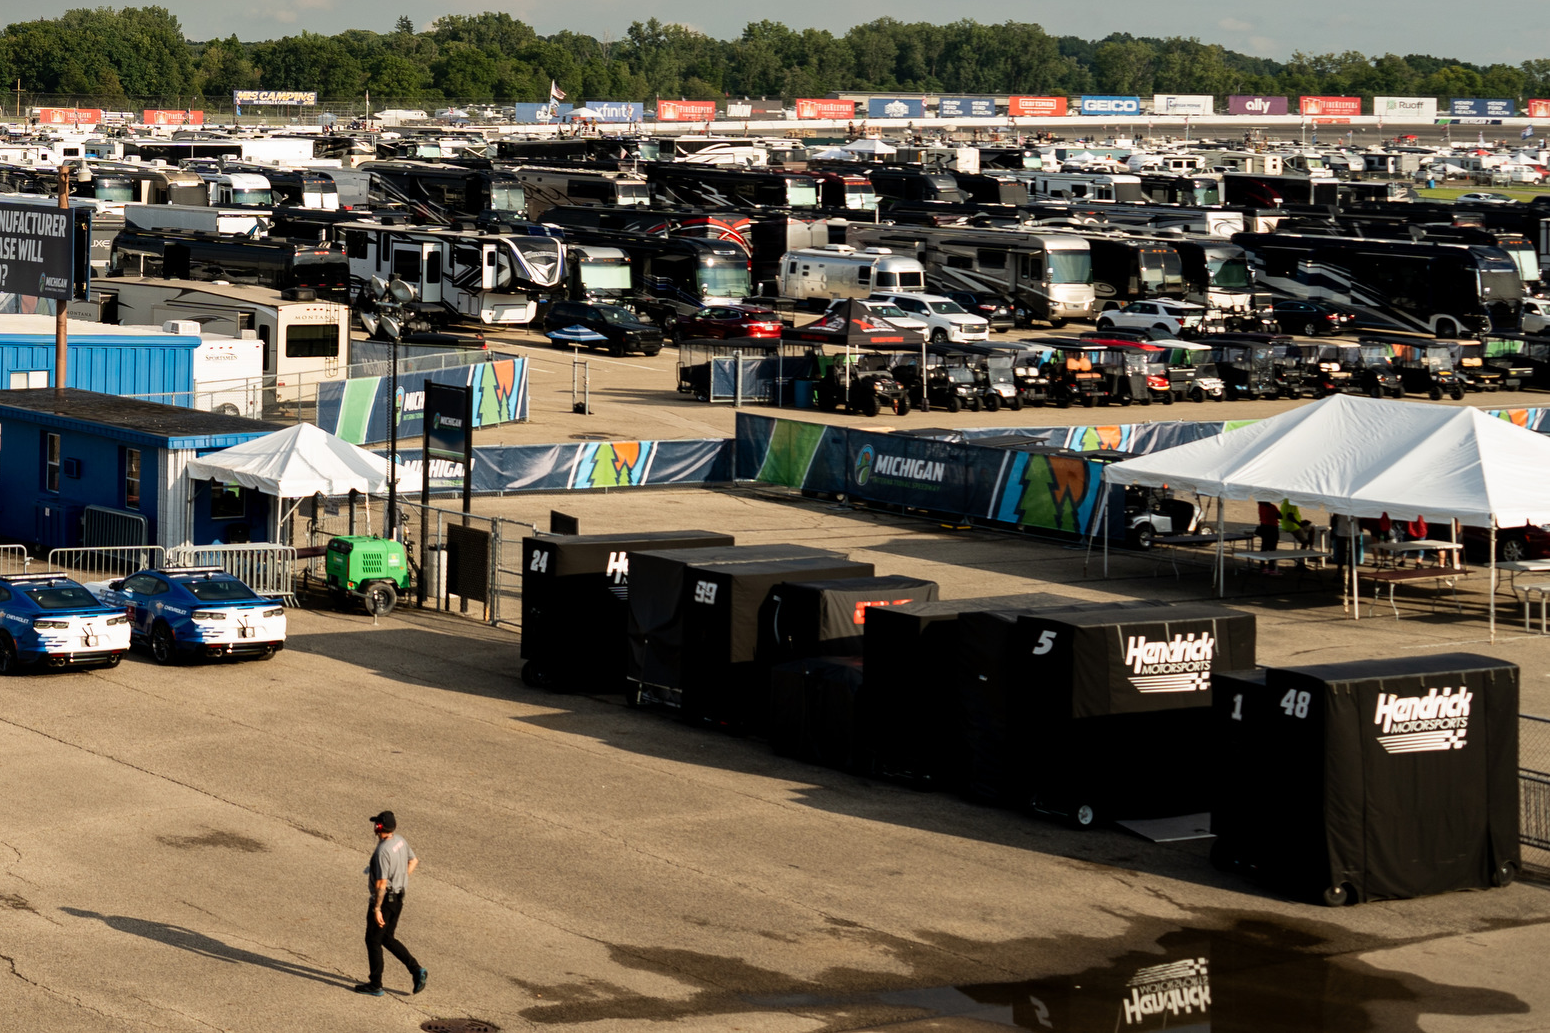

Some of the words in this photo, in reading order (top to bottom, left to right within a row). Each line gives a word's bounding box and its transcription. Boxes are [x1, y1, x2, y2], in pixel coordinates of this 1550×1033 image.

[259, 92, 315, 101] CAMPING
[1399, 101, 1424, 109] Ruoff
[595, 103, 635, 121] xfinity
[1084, 100, 1137, 112] GEICO
[1245, 98, 1270, 114] ally
[18, 239, 43, 263] WILL
[45, 276, 68, 288] MICHIGAN
[404, 391, 425, 411] MICH
[440, 416, 462, 427] MICHIGAN
[874, 454, 945, 482] MICHIGAN
[530, 549, 549, 573] 24
[694, 580, 718, 604] 99
[6, 613, 29, 624] CHEVROLET
[164, 604, 187, 615] CHEVROLET
[1032, 630, 1057, 655] 5
[1125, 632, 1214, 674] Hendrick
[1141, 661, 1211, 675] MOTORSPORTS
[1231, 693, 1243, 721] 1
[1280, 688, 1311, 719] 48
[1375, 686, 1473, 733] Hendrick
[1391, 717, 1468, 734] MOTORSPORTS
